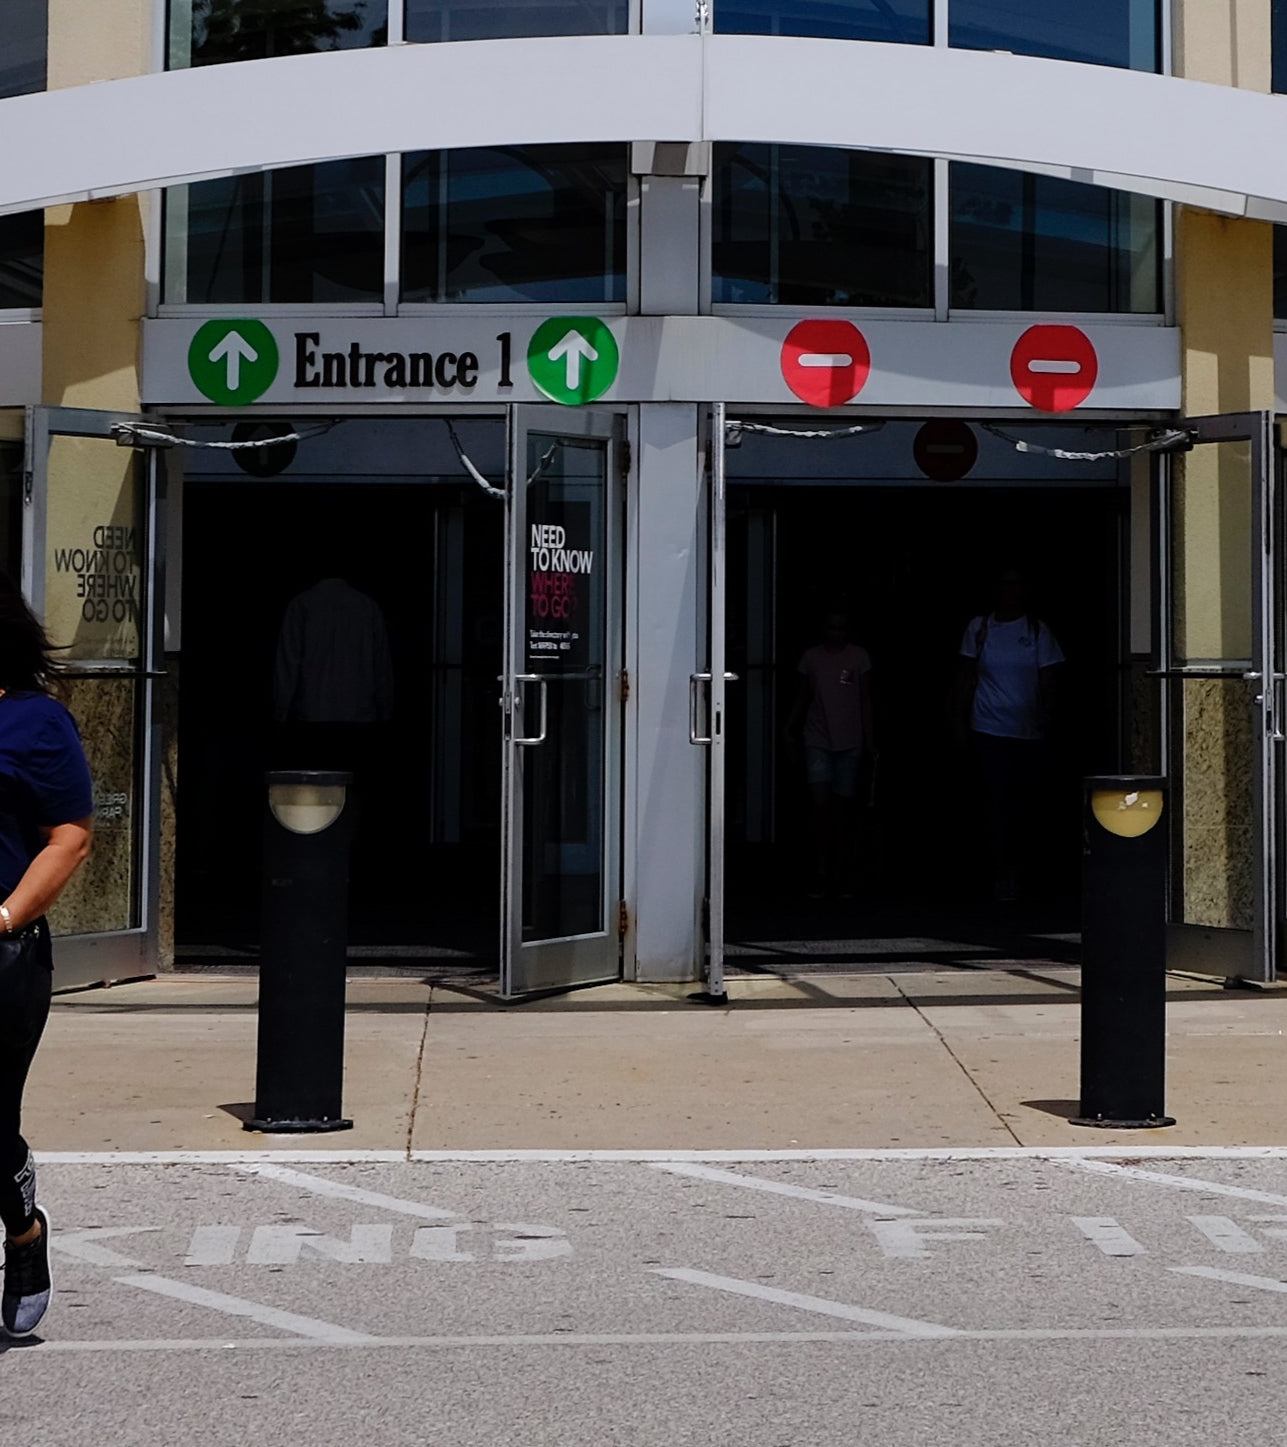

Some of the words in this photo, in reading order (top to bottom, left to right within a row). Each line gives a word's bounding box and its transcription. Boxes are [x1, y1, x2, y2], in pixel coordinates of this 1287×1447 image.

[293, 332, 478, 388] Entrance
[496, 332, 513, 388] 1
[531, 524, 566, 549] NEED
[531, 548, 550, 572] TO
[551, 548, 593, 574] KNOW
[531, 594, 549, 617] TO
